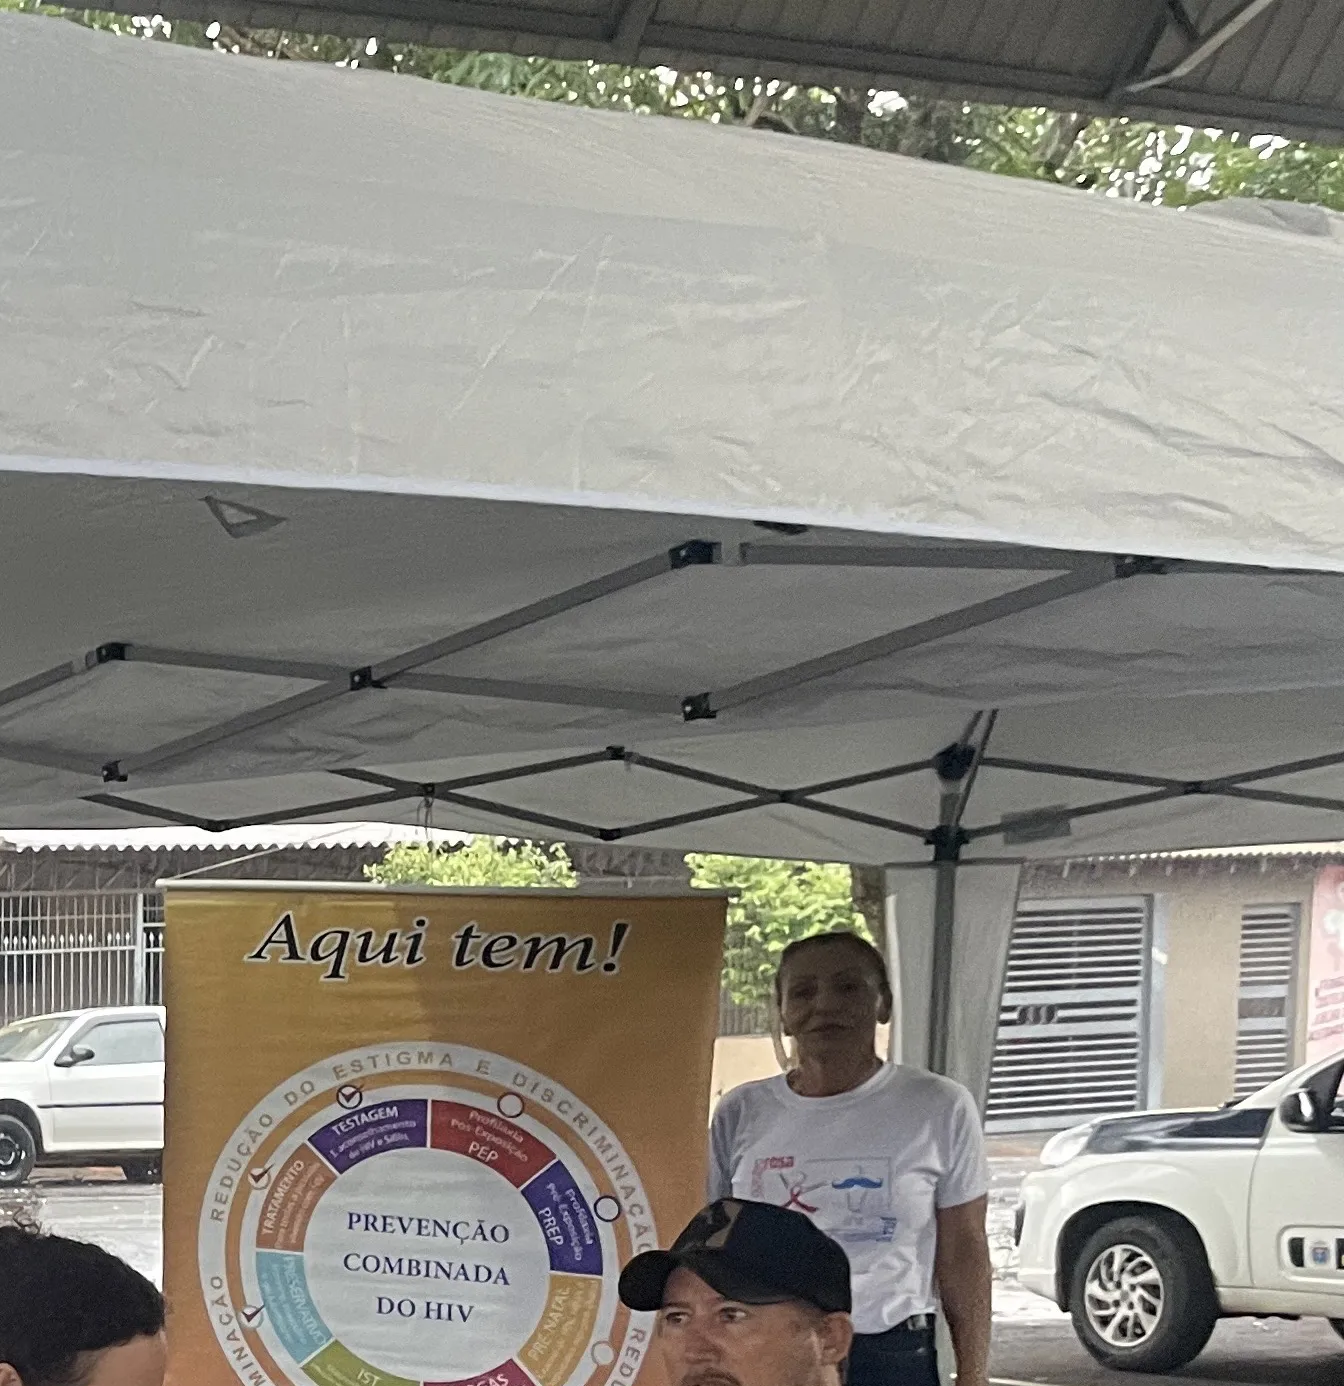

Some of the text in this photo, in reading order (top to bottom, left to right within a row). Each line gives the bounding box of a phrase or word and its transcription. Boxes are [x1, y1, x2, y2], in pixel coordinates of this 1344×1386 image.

[248, 912, 630, 981] Aqui tem!
[210, 1113, 273, 1223] REDUÇÃO
[284, 1080, 316, 1106] DO
[332, 1050, 453, 1080] ESTIGMA
[475, 1059, 491, 1075] E
[331, 1106, 399, 1137] TESTAGEM
[468, 1141, 499, 1163] PEP
[262, 1159, 305, 1236] TRATAMENTO
[347, 1212, 510, 1245] PREVENÇÃO
[538, 1207, 564, 1246] PREP
[343, 1253, 510, 1286] COMBINADA
[376, 1296, 475, 1323] DO HIV
